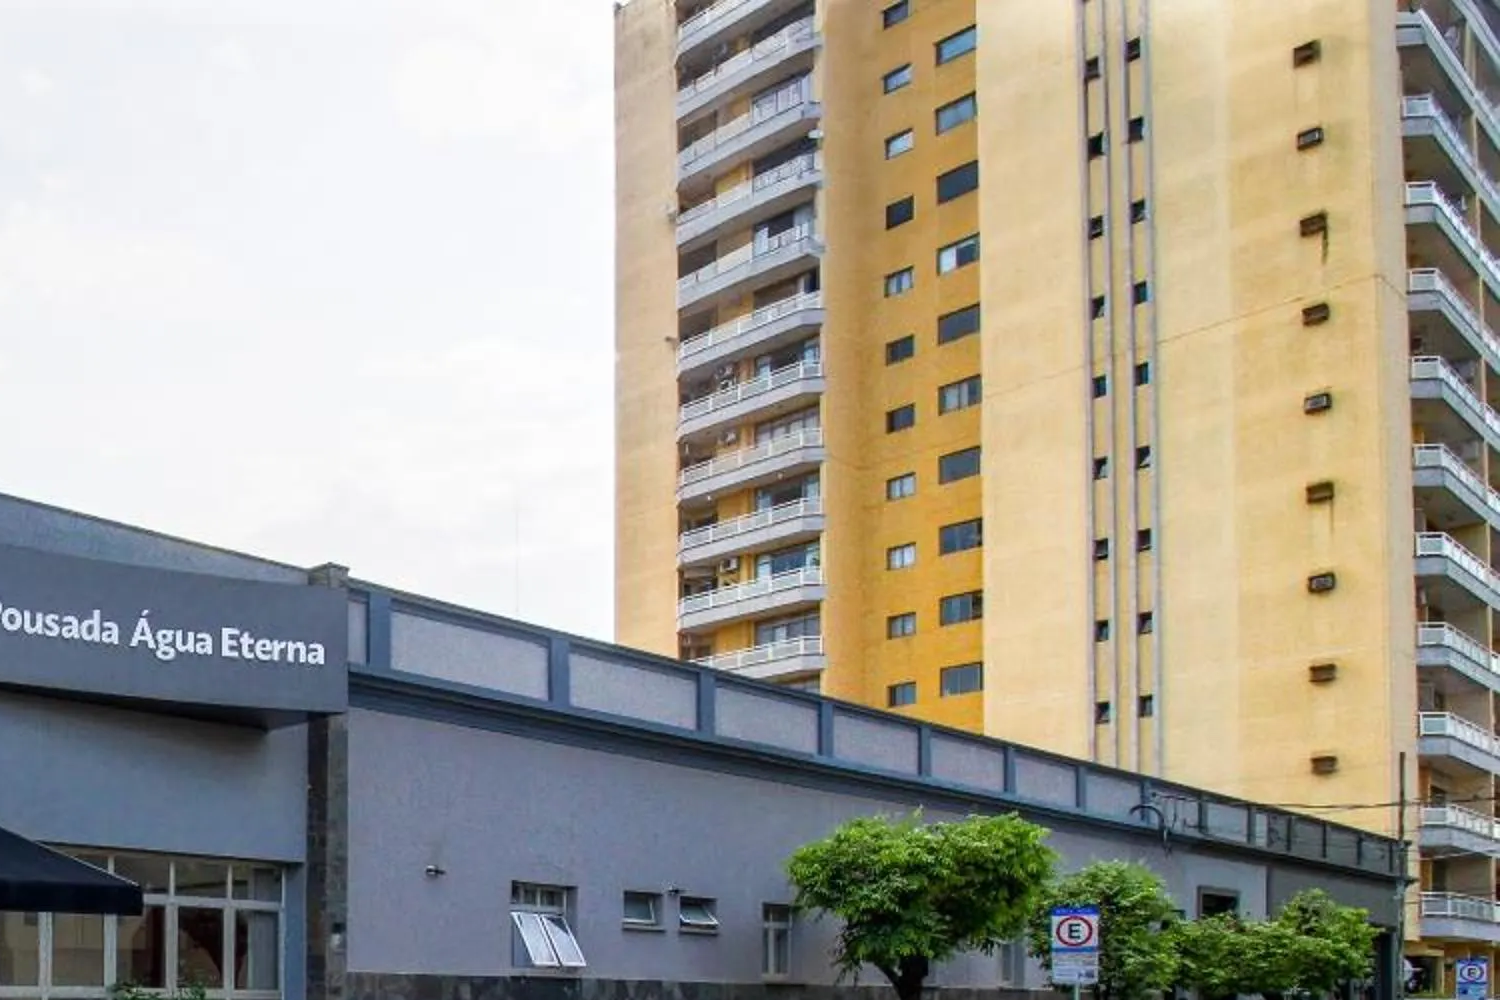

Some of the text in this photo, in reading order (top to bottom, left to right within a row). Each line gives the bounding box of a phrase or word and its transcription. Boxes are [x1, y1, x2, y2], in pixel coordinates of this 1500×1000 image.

[130, 609, 212, 660] Água
[221, 627, 325, 665] Eterna
[1067, 923, 1082, 940] E
